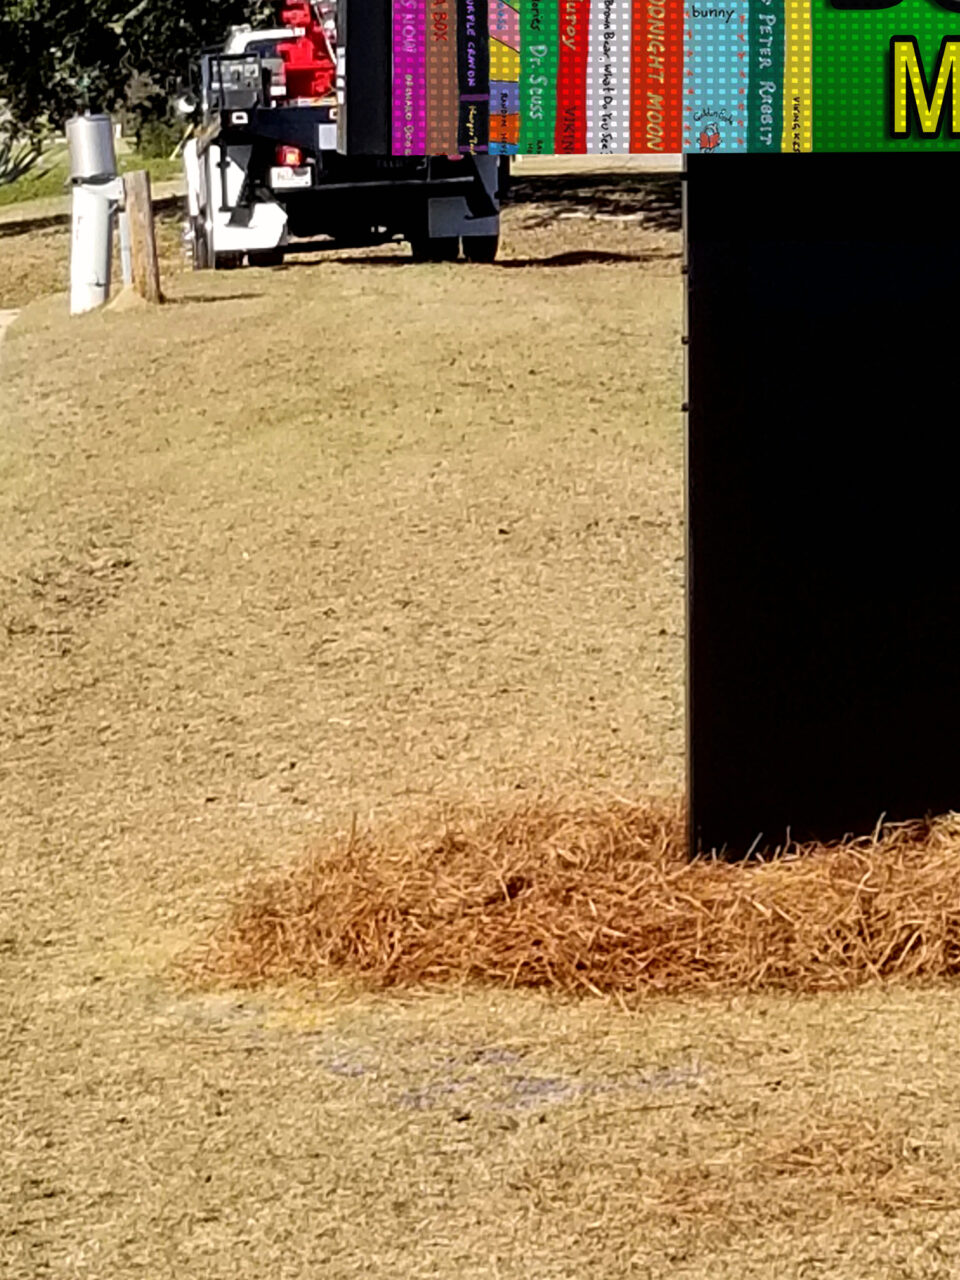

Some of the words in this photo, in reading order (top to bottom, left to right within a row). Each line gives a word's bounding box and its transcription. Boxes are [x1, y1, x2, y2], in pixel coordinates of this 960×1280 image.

[434, 12, 448, 42] BOX
[604, 0, 614, 29] Brown
[692, 6, 735, 24] bunny
[530, 44, 548, 68] Dr.
[758, 14, 776, 69] PETER
[602, 64, 614, 92] What
[529, 74, 547, 120] Seuss
[561, 106, 576, 154] VIKIN
[646, 92, 663, 151] MOON
